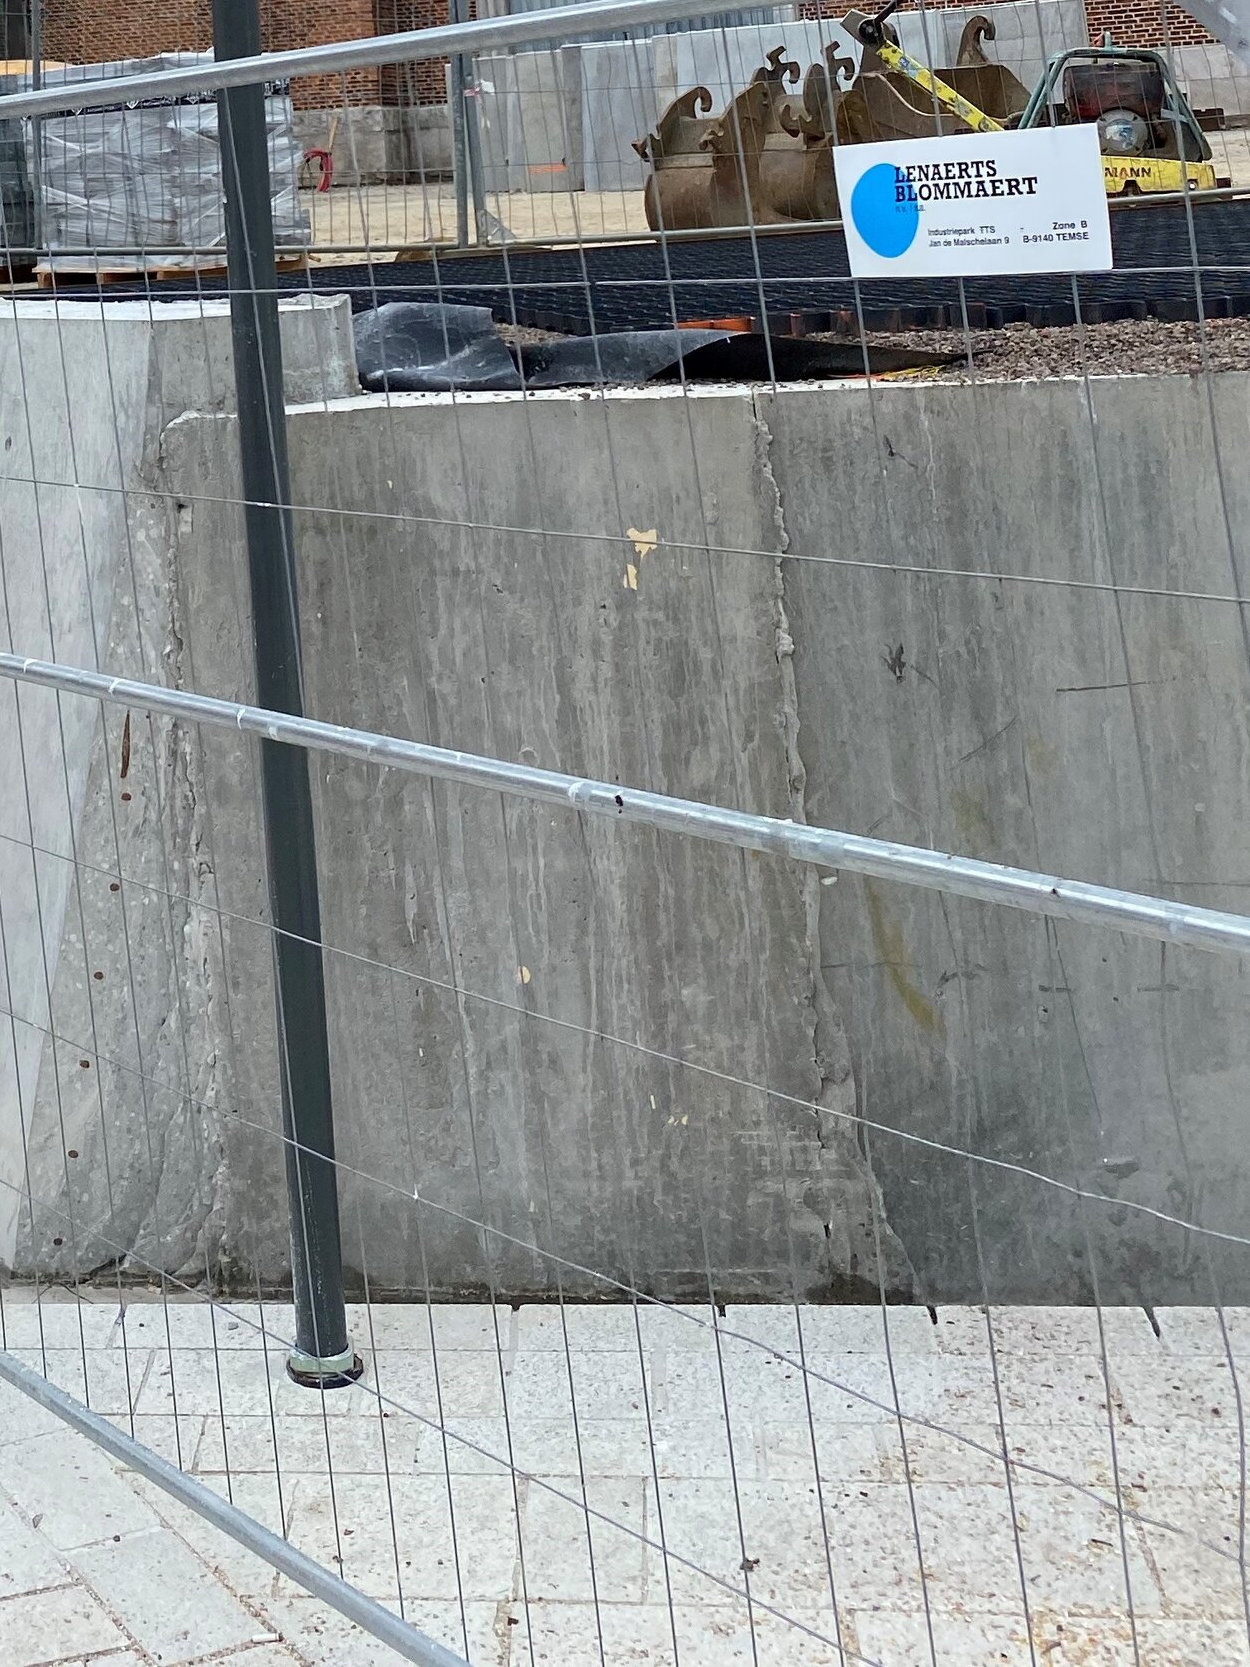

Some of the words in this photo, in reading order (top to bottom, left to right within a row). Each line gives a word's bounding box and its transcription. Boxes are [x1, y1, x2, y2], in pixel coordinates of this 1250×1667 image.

[894, 159, 997, 183] LENAERTS
[894, 176, 1038, 202] BLOMMAERT
[979, 225, 996, 234] TTS
[1052, 221, 1076, 230] Zone
[1080, 220, 1088, 229] B
[929, 239, 942, 247] Jan
[1004, 236, 1010, 245] 9
[1022, 234, 1054, 244] B-9140
[1056, 231, 1090, 241] TEMSE
